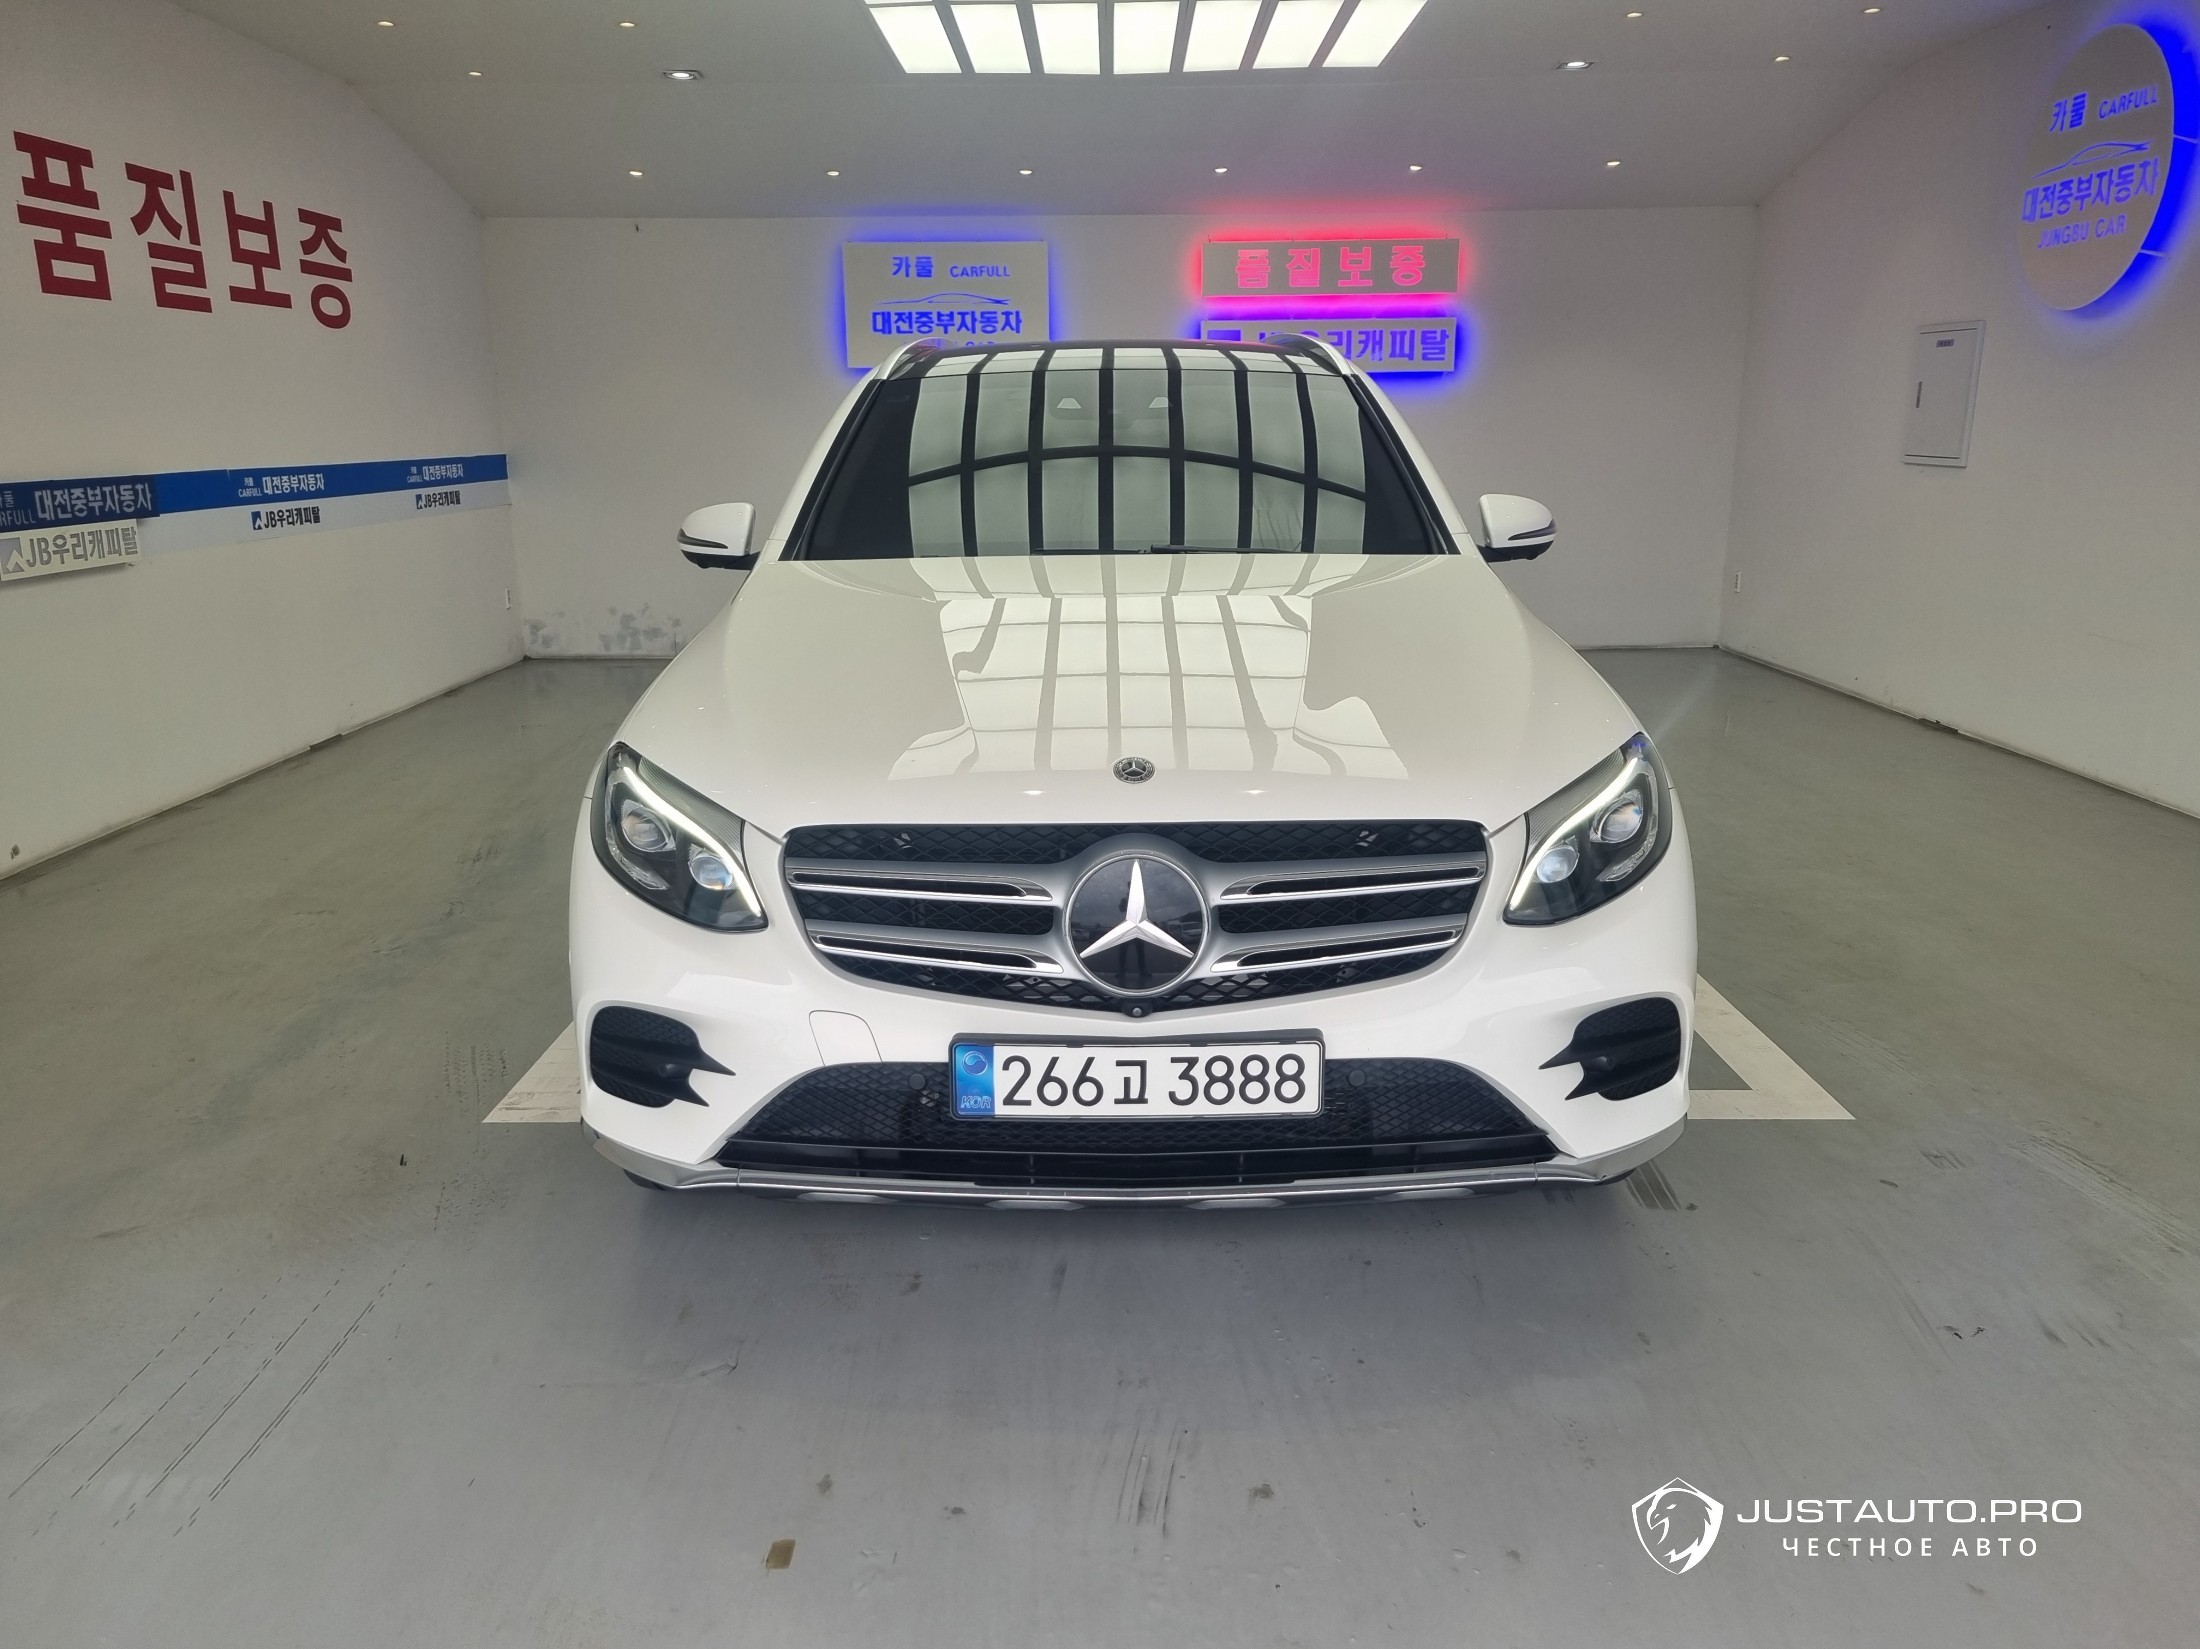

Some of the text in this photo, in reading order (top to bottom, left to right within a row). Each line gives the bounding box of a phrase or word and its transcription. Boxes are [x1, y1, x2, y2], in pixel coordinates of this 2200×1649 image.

[2099, 84, 2158, 119] CARFULL
[2022, 157, 2160, 222] 대전중부자동차
[13, 130, 353, 329] 품질보증
[2038, 214, 2127, 249] JUNGBU CAR
[950, 265, 1010, 278] CARFULL
[871, 310, 1023, 335] 대전중부자동차
[262, 473, 325, 495] 대전중부자동차
[423, 464, 464, 481] 대전중부자동차
[34, 482, 152, 521] 대전중부자동차
[264, 505, 321, 529] JB우리캐피탈
[26, 526, 139, 568] JB우리캐피탈
[1168, 1053, 1306, 1106] 3888
[960, 1095, 992, 1109] KOR
